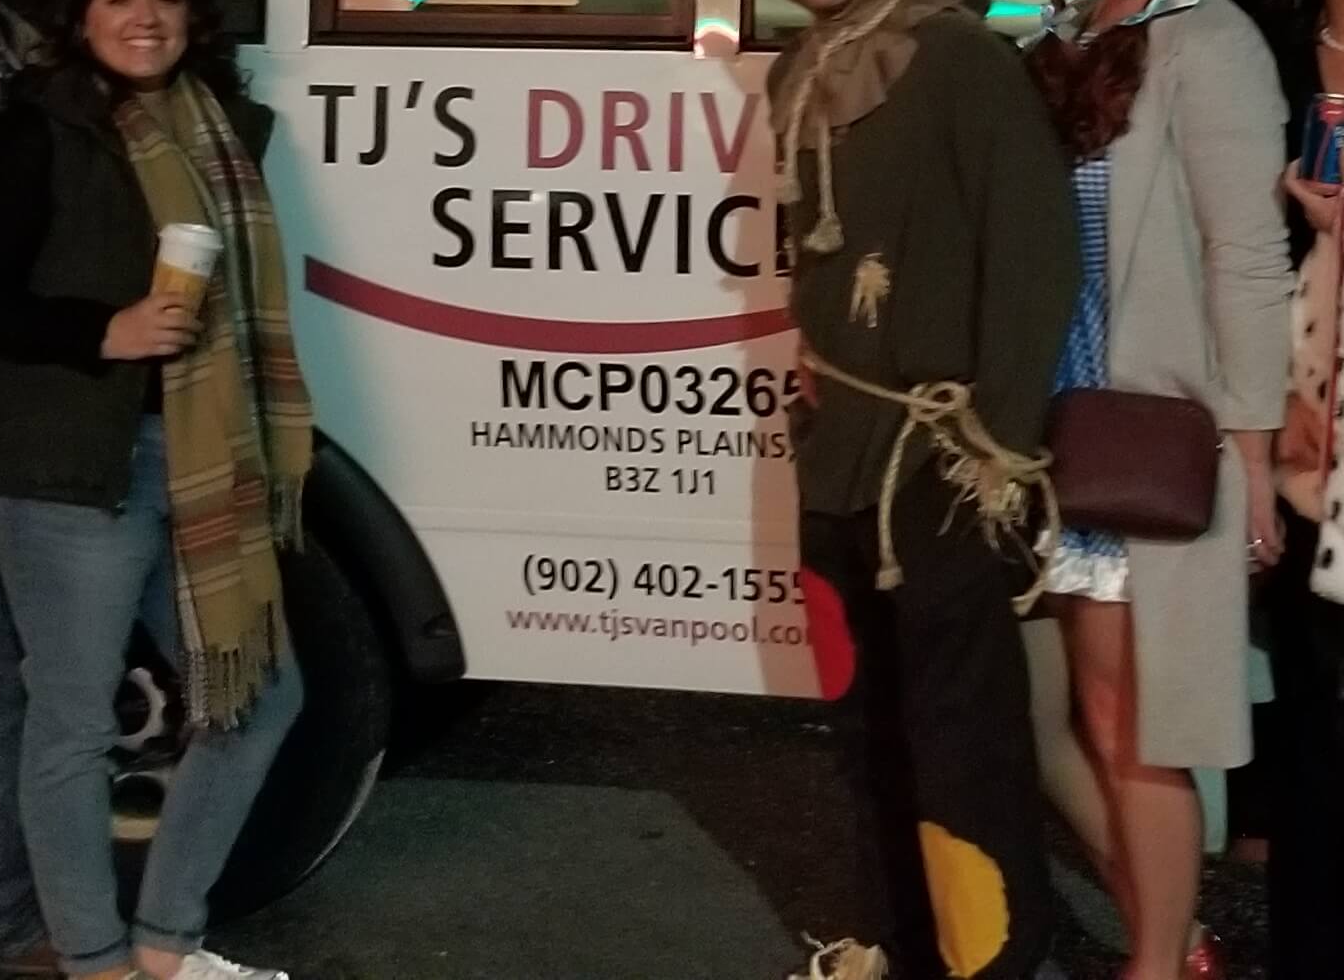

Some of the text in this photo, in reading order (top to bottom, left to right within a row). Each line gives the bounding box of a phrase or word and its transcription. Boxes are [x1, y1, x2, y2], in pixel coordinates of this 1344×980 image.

[308, 80, 785, 175] TJ'S DRIV
[470, 421, 666, 454] HAMMONDS
[605, 466, 715, 495] B3Z 1J1
[523, 554, 619, 600] (902)
[505, 609, 808, 646] www.tjsvanpool.co
